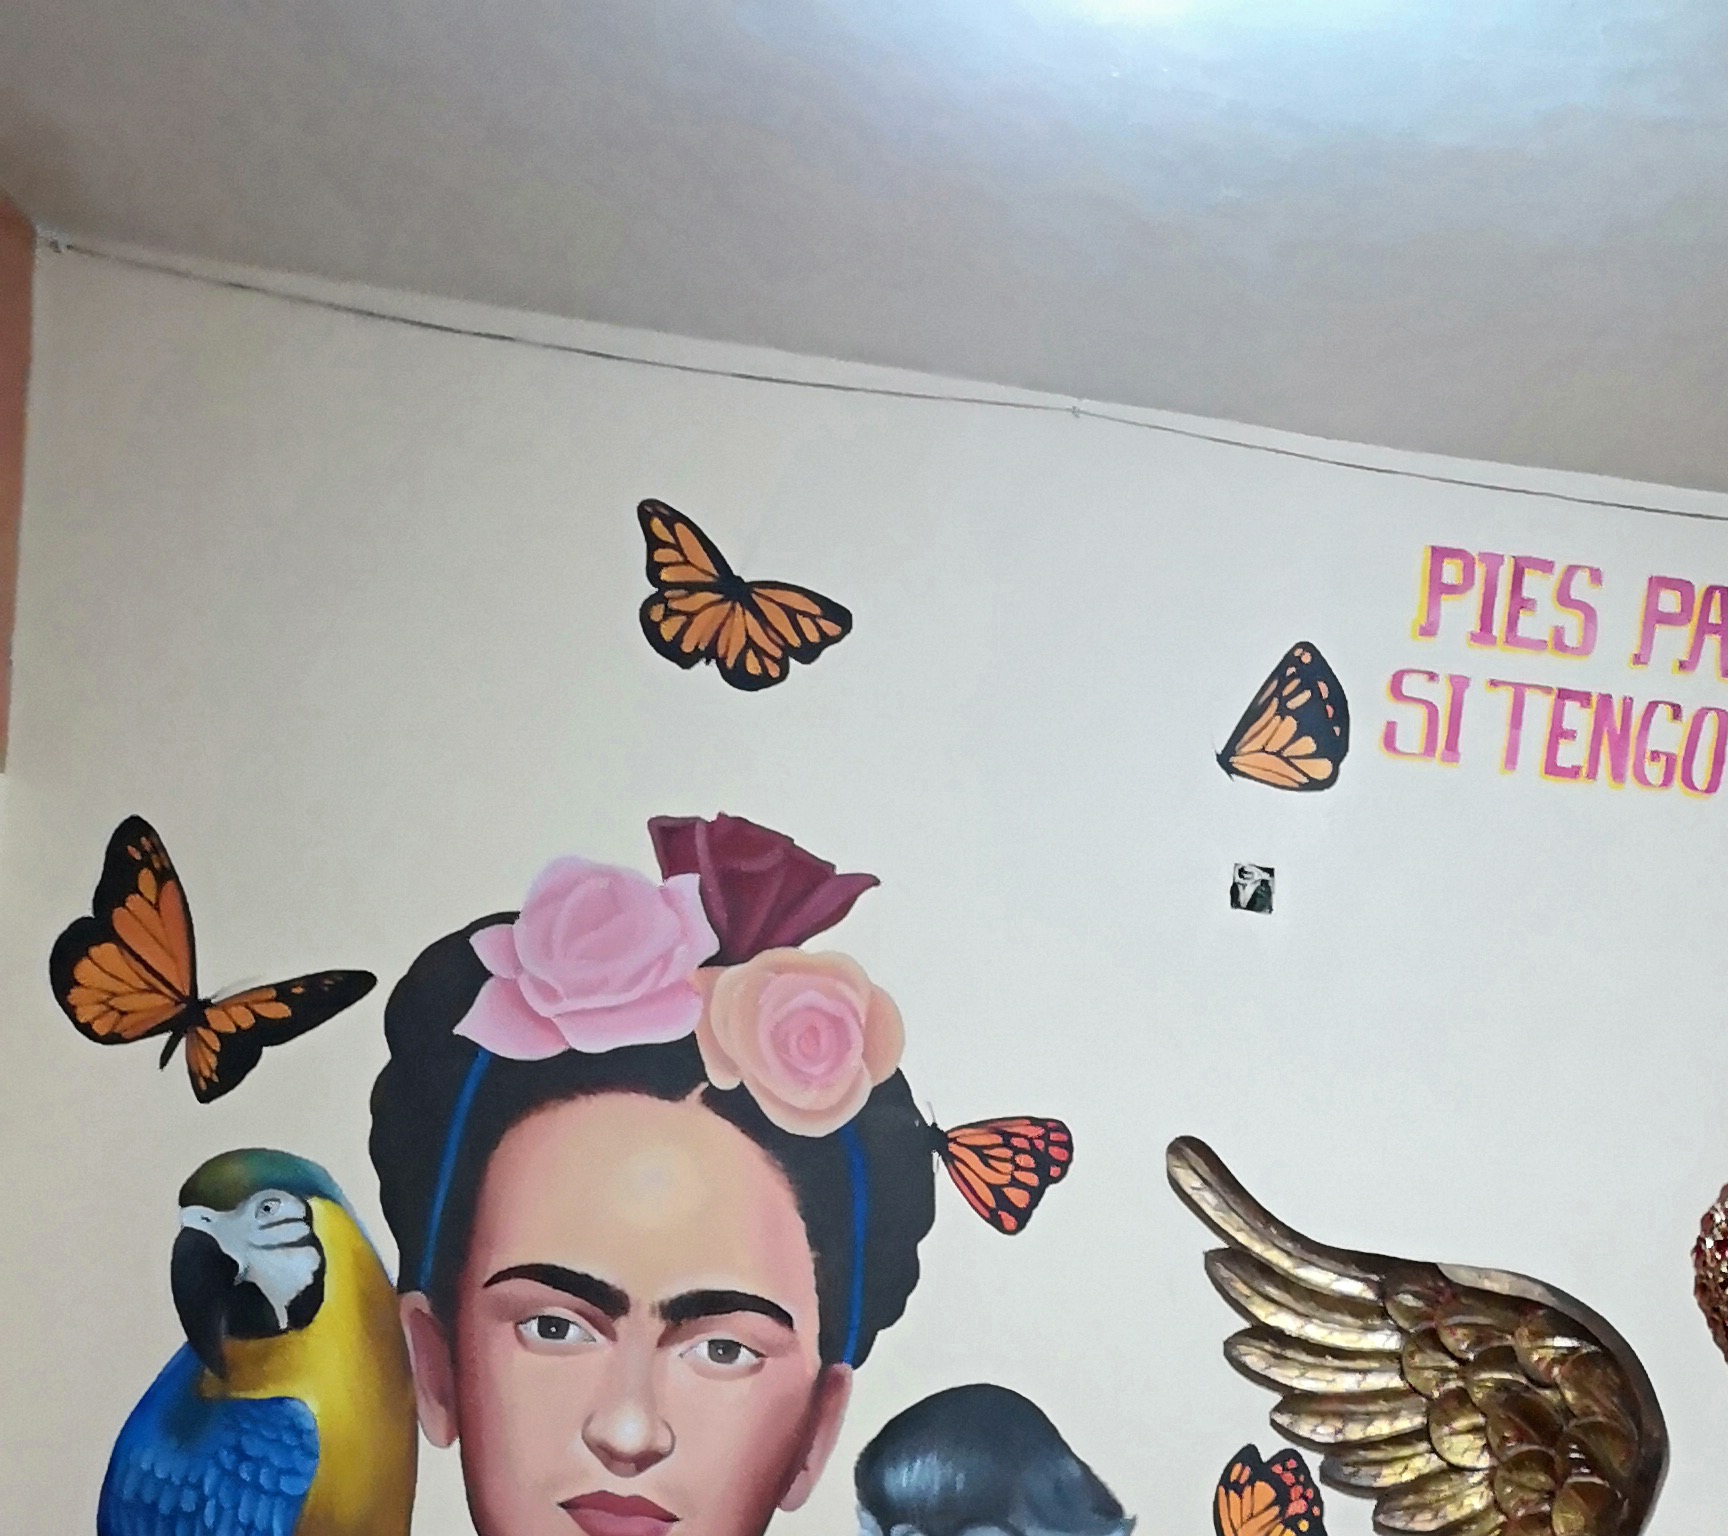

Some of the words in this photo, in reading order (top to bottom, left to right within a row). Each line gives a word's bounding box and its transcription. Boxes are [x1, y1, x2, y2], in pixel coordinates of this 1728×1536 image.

[1410, 546, 1602, 660] PIES
[1379, 669, 1470, 768] SI
[1485, 679, 1728, 799] TENGO
